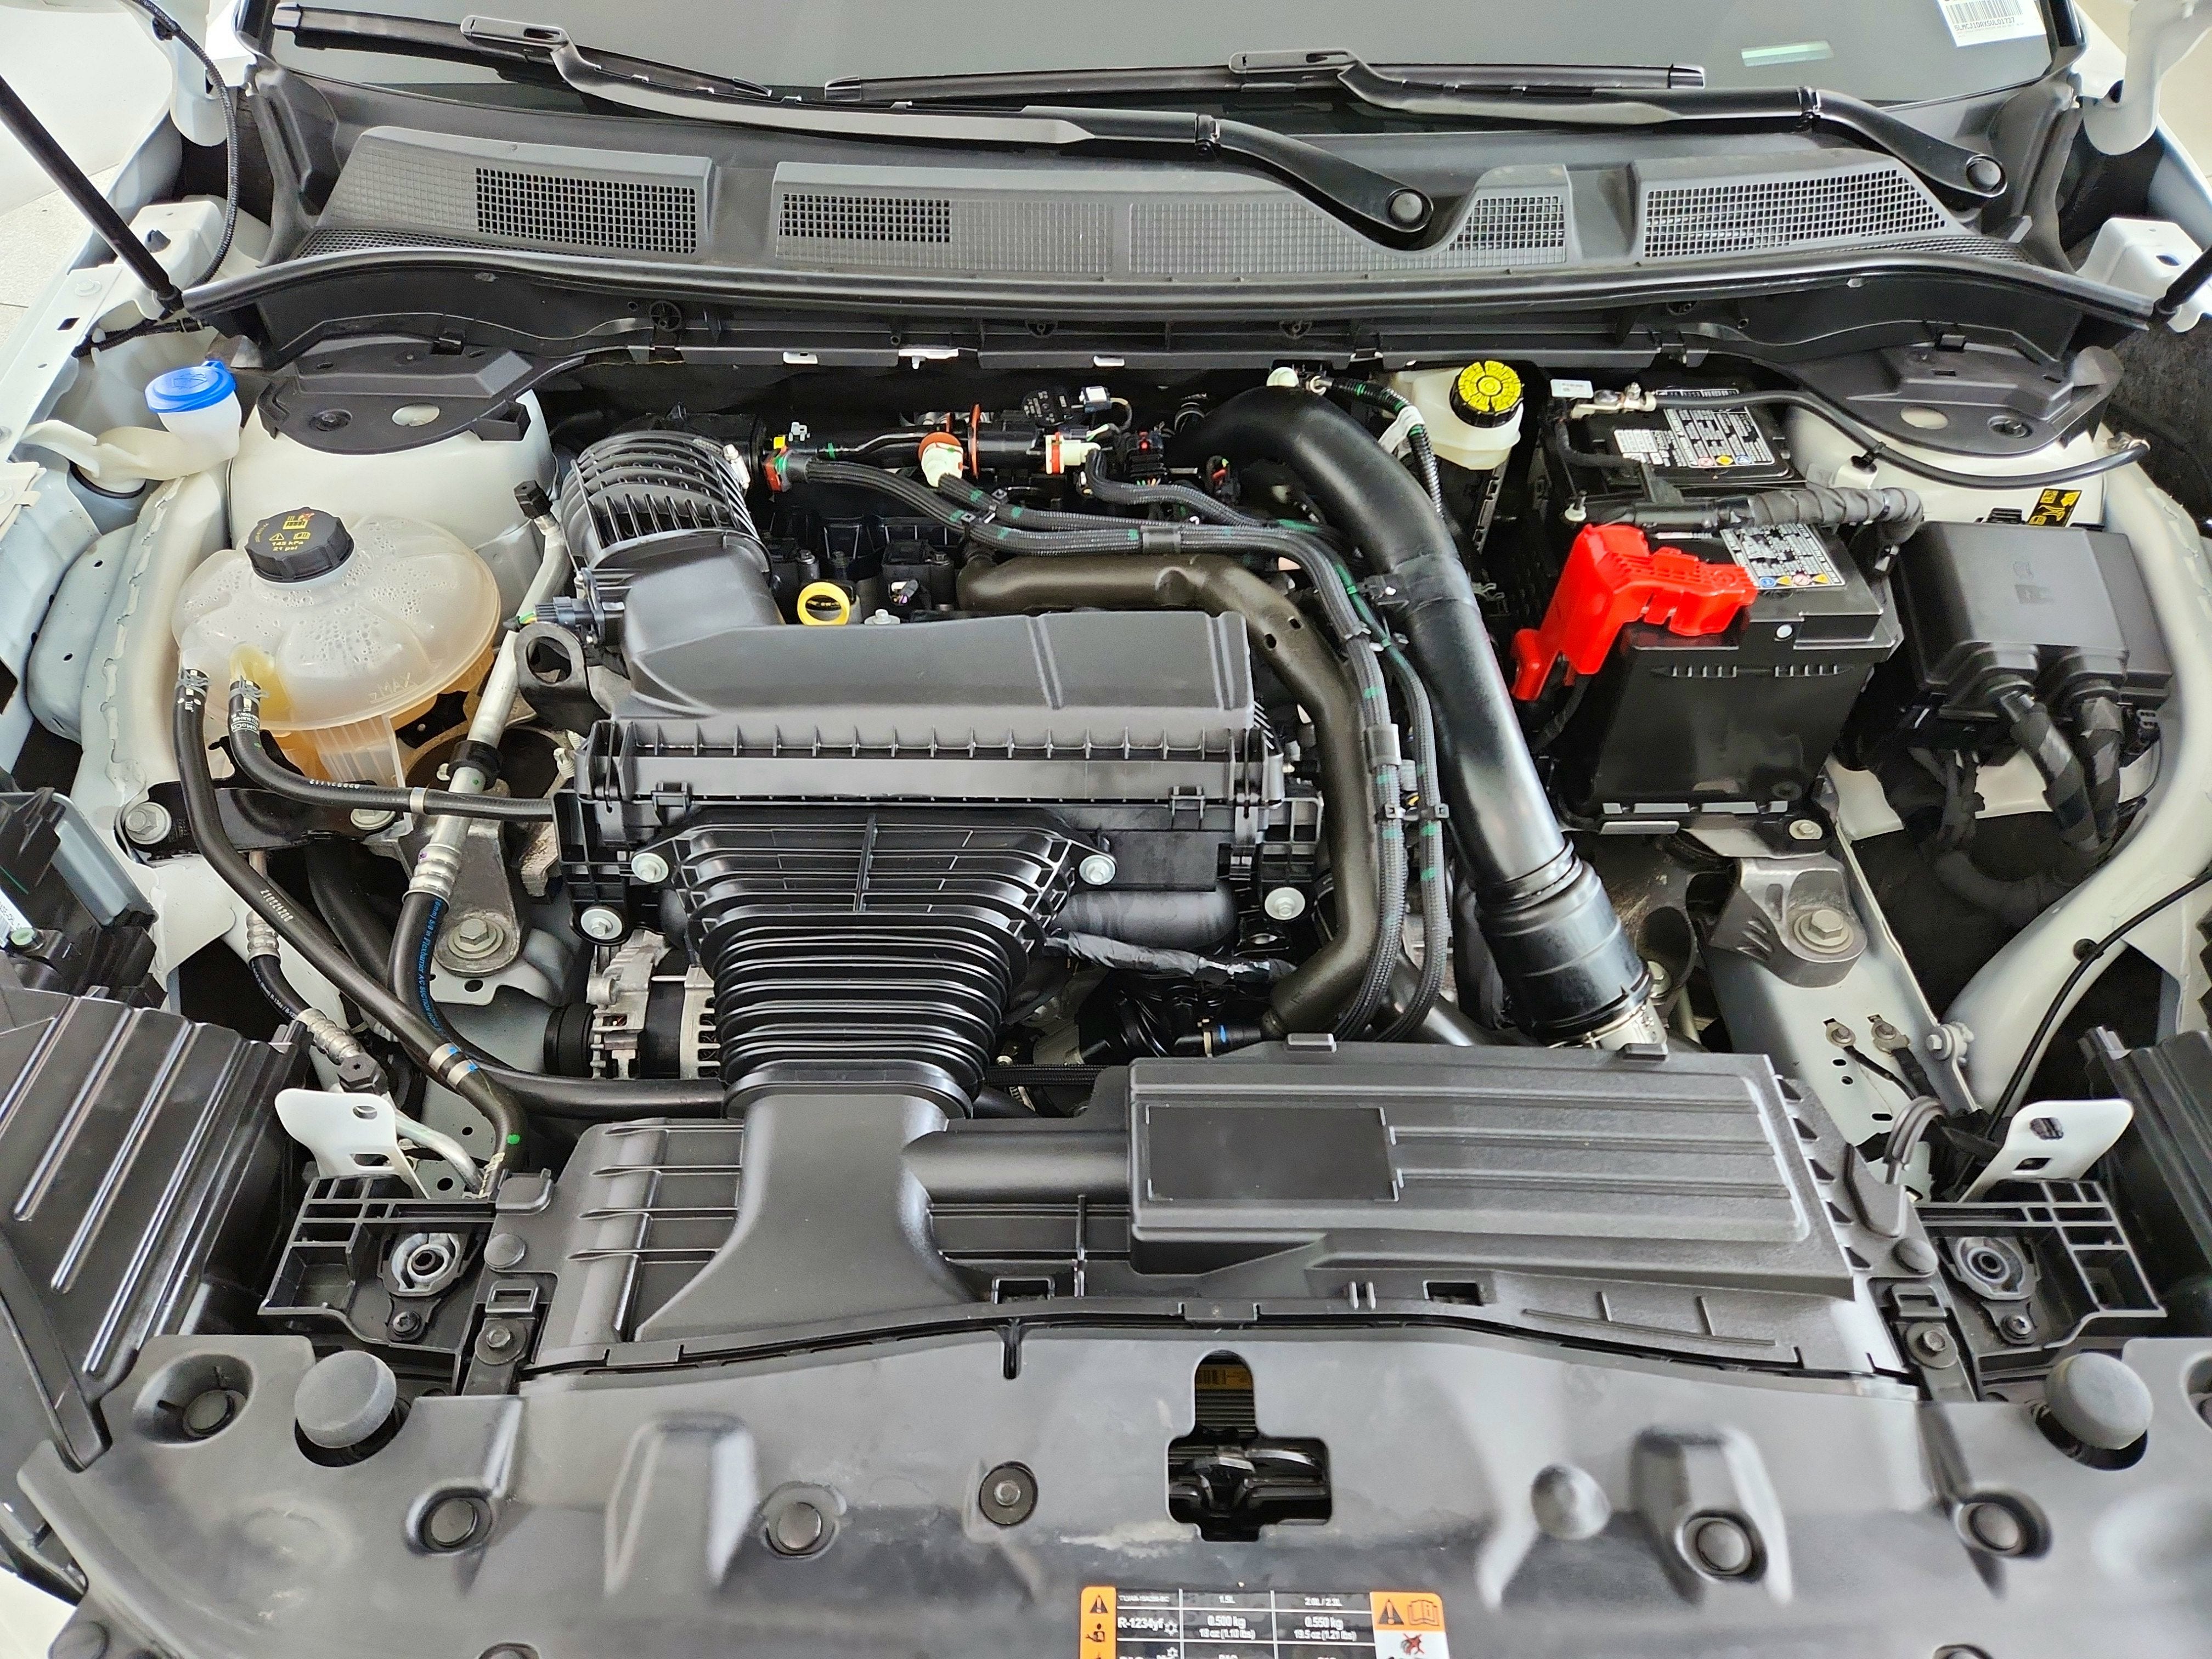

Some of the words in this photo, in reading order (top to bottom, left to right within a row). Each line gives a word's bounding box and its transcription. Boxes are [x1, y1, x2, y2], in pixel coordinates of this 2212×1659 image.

[417, 935, 431, 974] Flexbarrier
[419, 985, 432, 1012] SUCTION
[1117, 1616, 1164, 1632] R-1234yf
[1207, 1615, 1232, 1627] 0.500
[1232, 1615, 1246, 1629] kg
[1330, 1616, 1344, 1630] kg
[1340, 1630, 1357, 1642] lbs)
